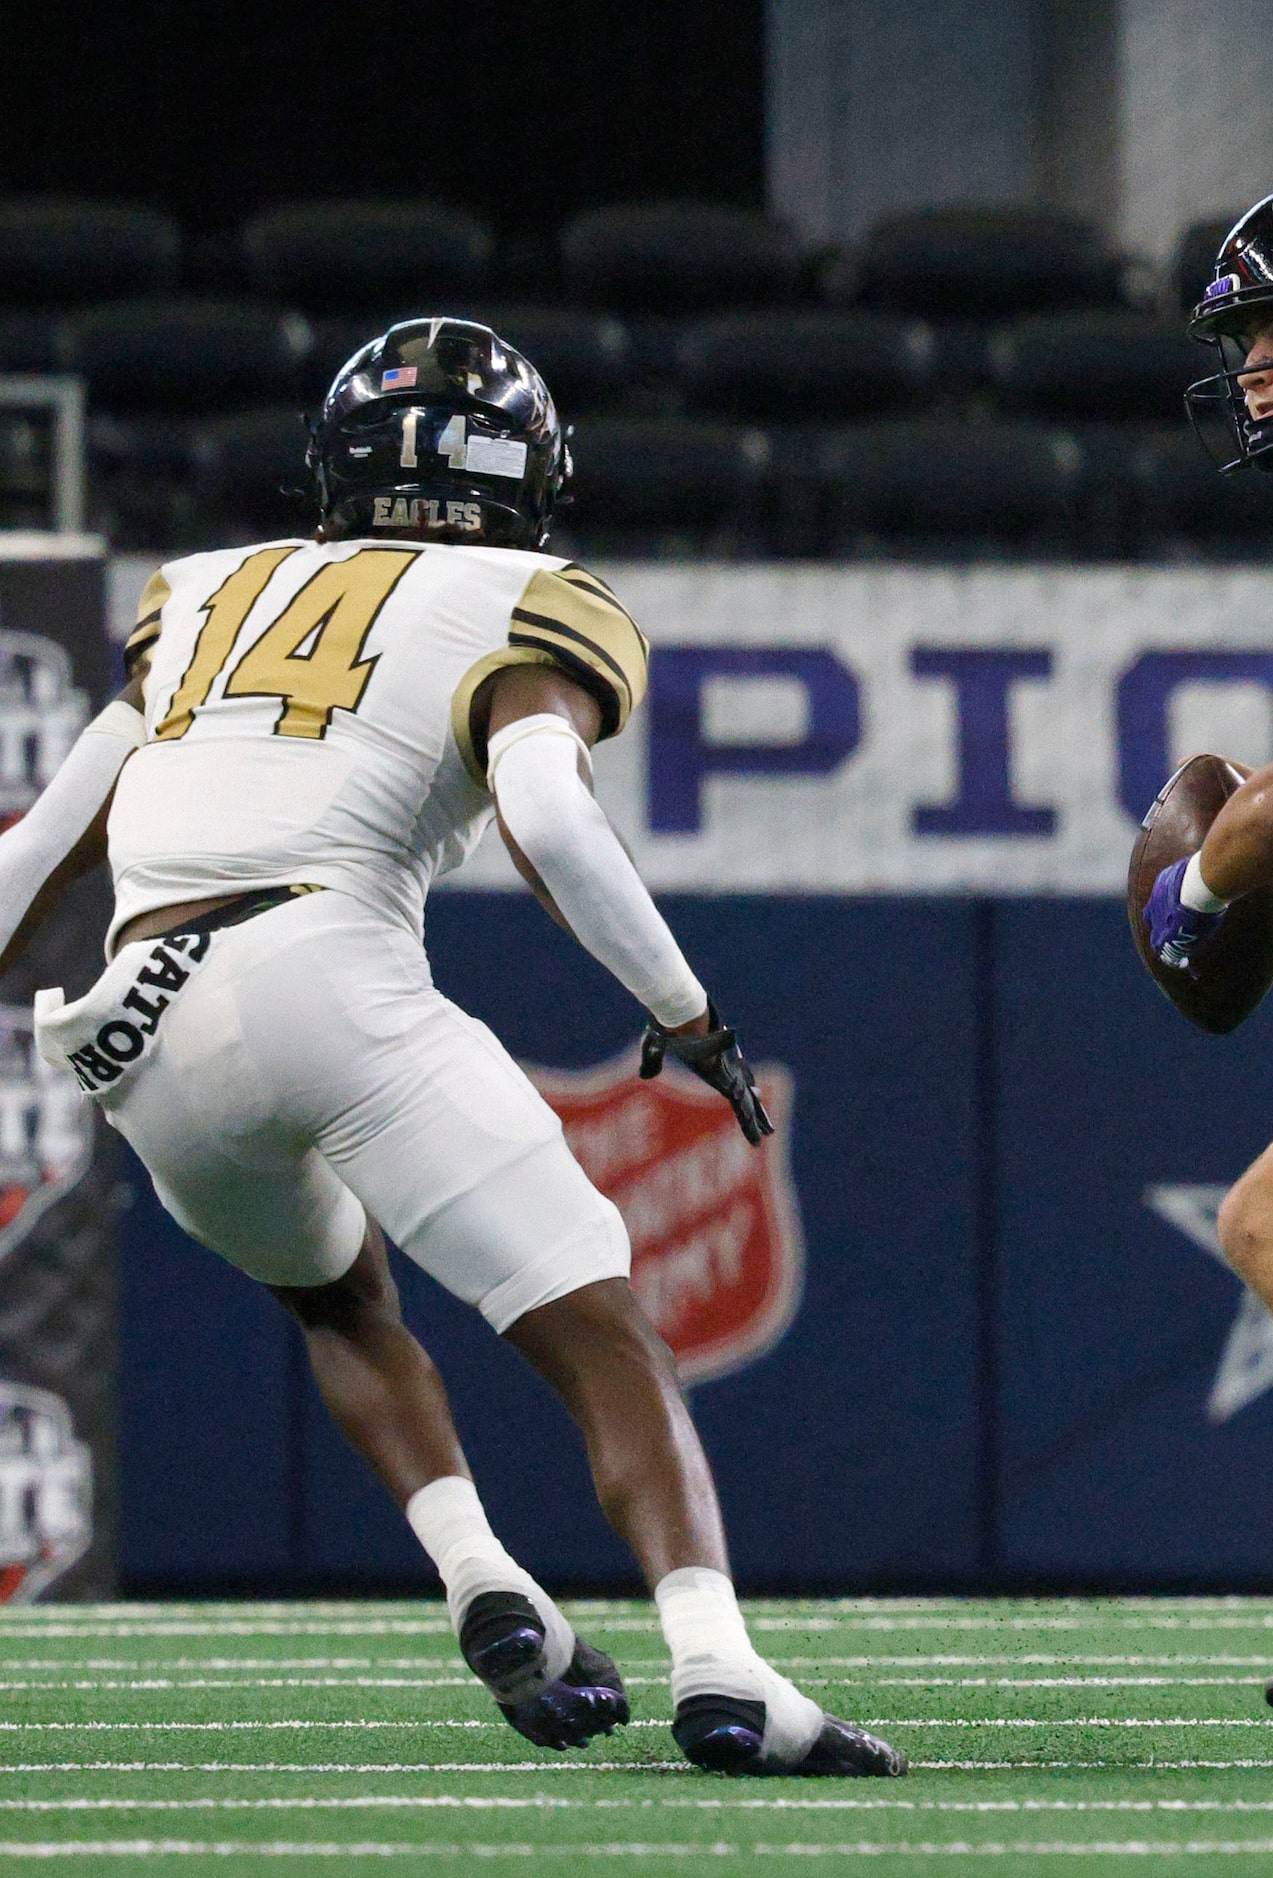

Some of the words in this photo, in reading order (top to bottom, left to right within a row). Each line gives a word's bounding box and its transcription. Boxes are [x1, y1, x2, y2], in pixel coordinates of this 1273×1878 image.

[400, 414, 467, 470] 14
[372, 496, 482, 532] EAGLES
[147, 546, 426, 745] 14
